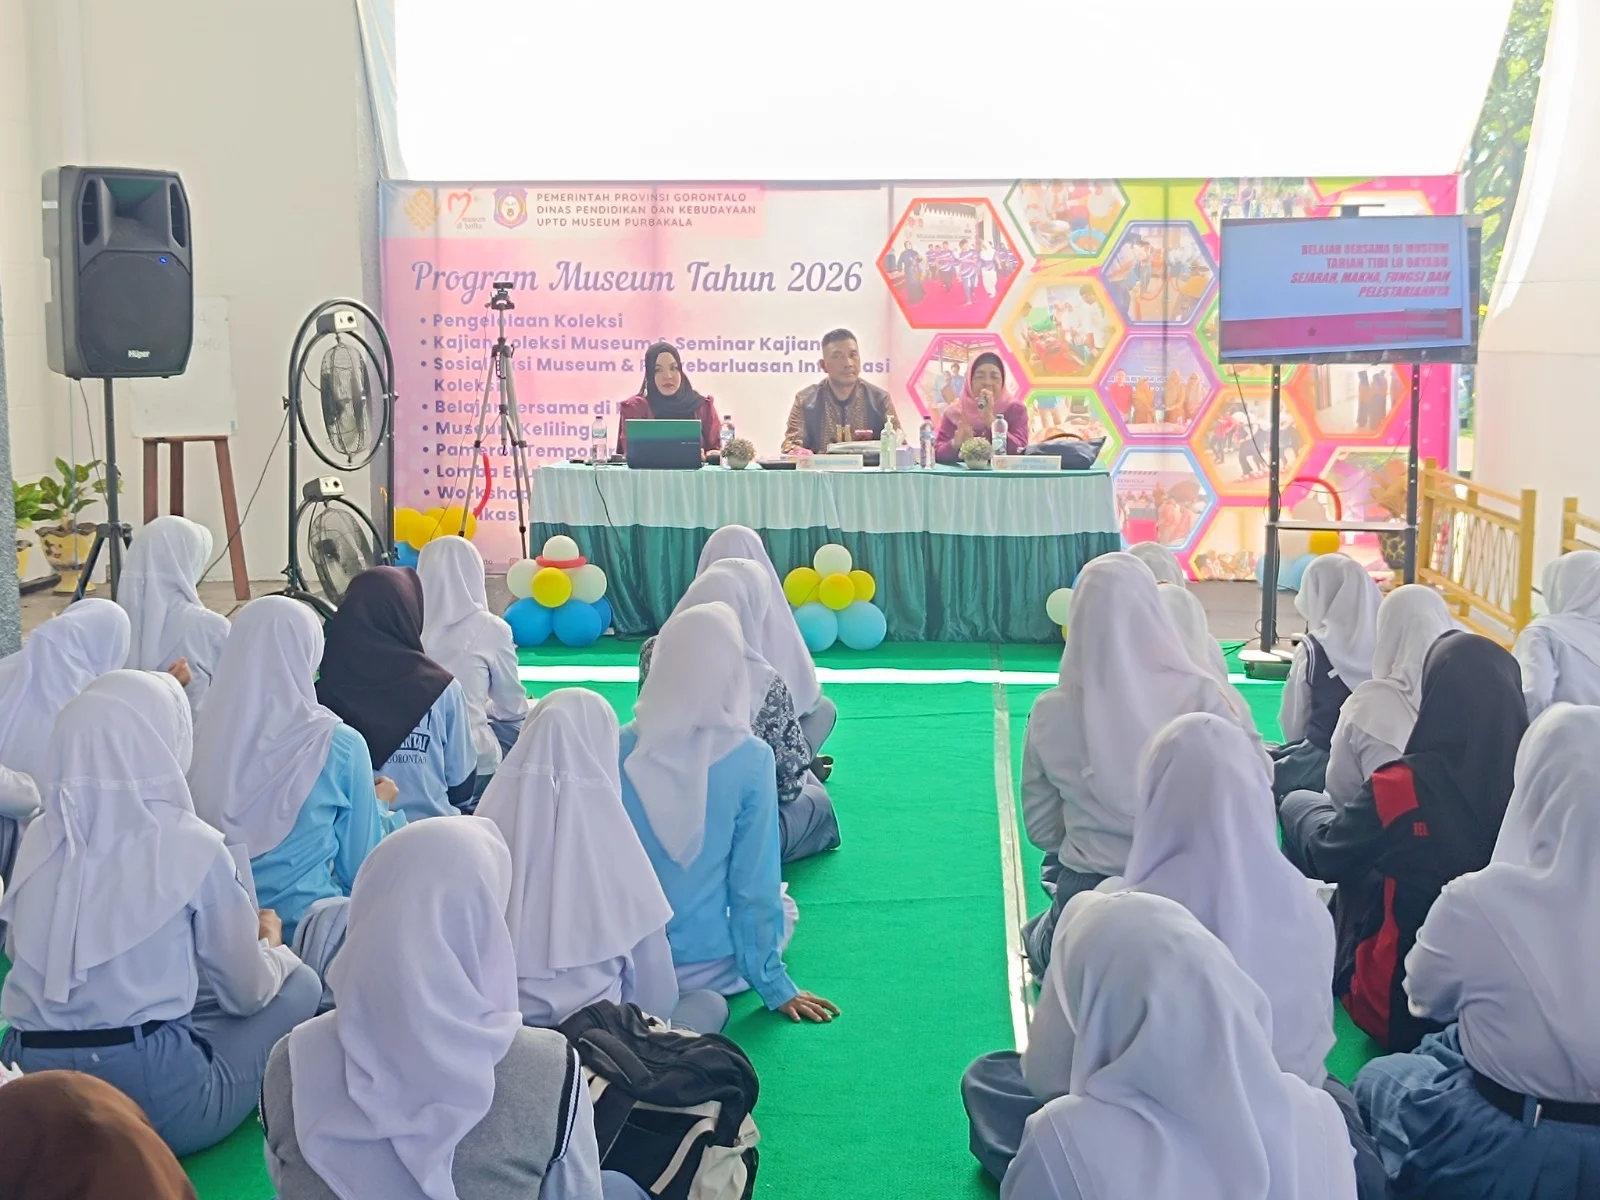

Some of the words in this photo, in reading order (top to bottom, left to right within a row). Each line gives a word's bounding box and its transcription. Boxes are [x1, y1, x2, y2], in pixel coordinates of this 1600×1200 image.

[536, 193, 610, 202] PEMERINTAH
[614, 193, 669, 202] PROVINSI
[673, 193, 747, 202] GORONTALO
[536, 206, 571, 214] DINAS
[576, 206, 646, 214] PENDIDIKAN
[651, 206, 675, 214] DAN
[678, 206, 756, 214] KEBUDAYAAN
[536, 218, 567, 227] UPTD
[571, 218, 620, 227] MUSEUM
[624, 218, 693, 227] PURBAKALA
[411, 260, 539, 305] Program
[549, 260, 676, 292] Museum
[686, 261, 776, 292] Tahun
[787, 261, 863, 292] 2026
[432, 313, 550, 331] Pengelolaan
[554, 313, 624, 328] Koleksi
[433, 335, 493, 353] Kajian
[504, 337, 567, 350] oleksi
[570, 337, 651, 351] Museum
[675, 335, 756, 351] Seminar
[759, 336, 822, 356] Kajian
[433, 355, 532, 372] Sosialsi
[536, 357, 616, 372] Museum
[620, 358, 634, 372] &
[798, 359, 891, 374] Infasi
[518, 402, 589, 415] ersama
[593, 400, 611, 415] di
[521, 423, 590, 439] Keliling
[436, 465, 498, 478] Lomba
